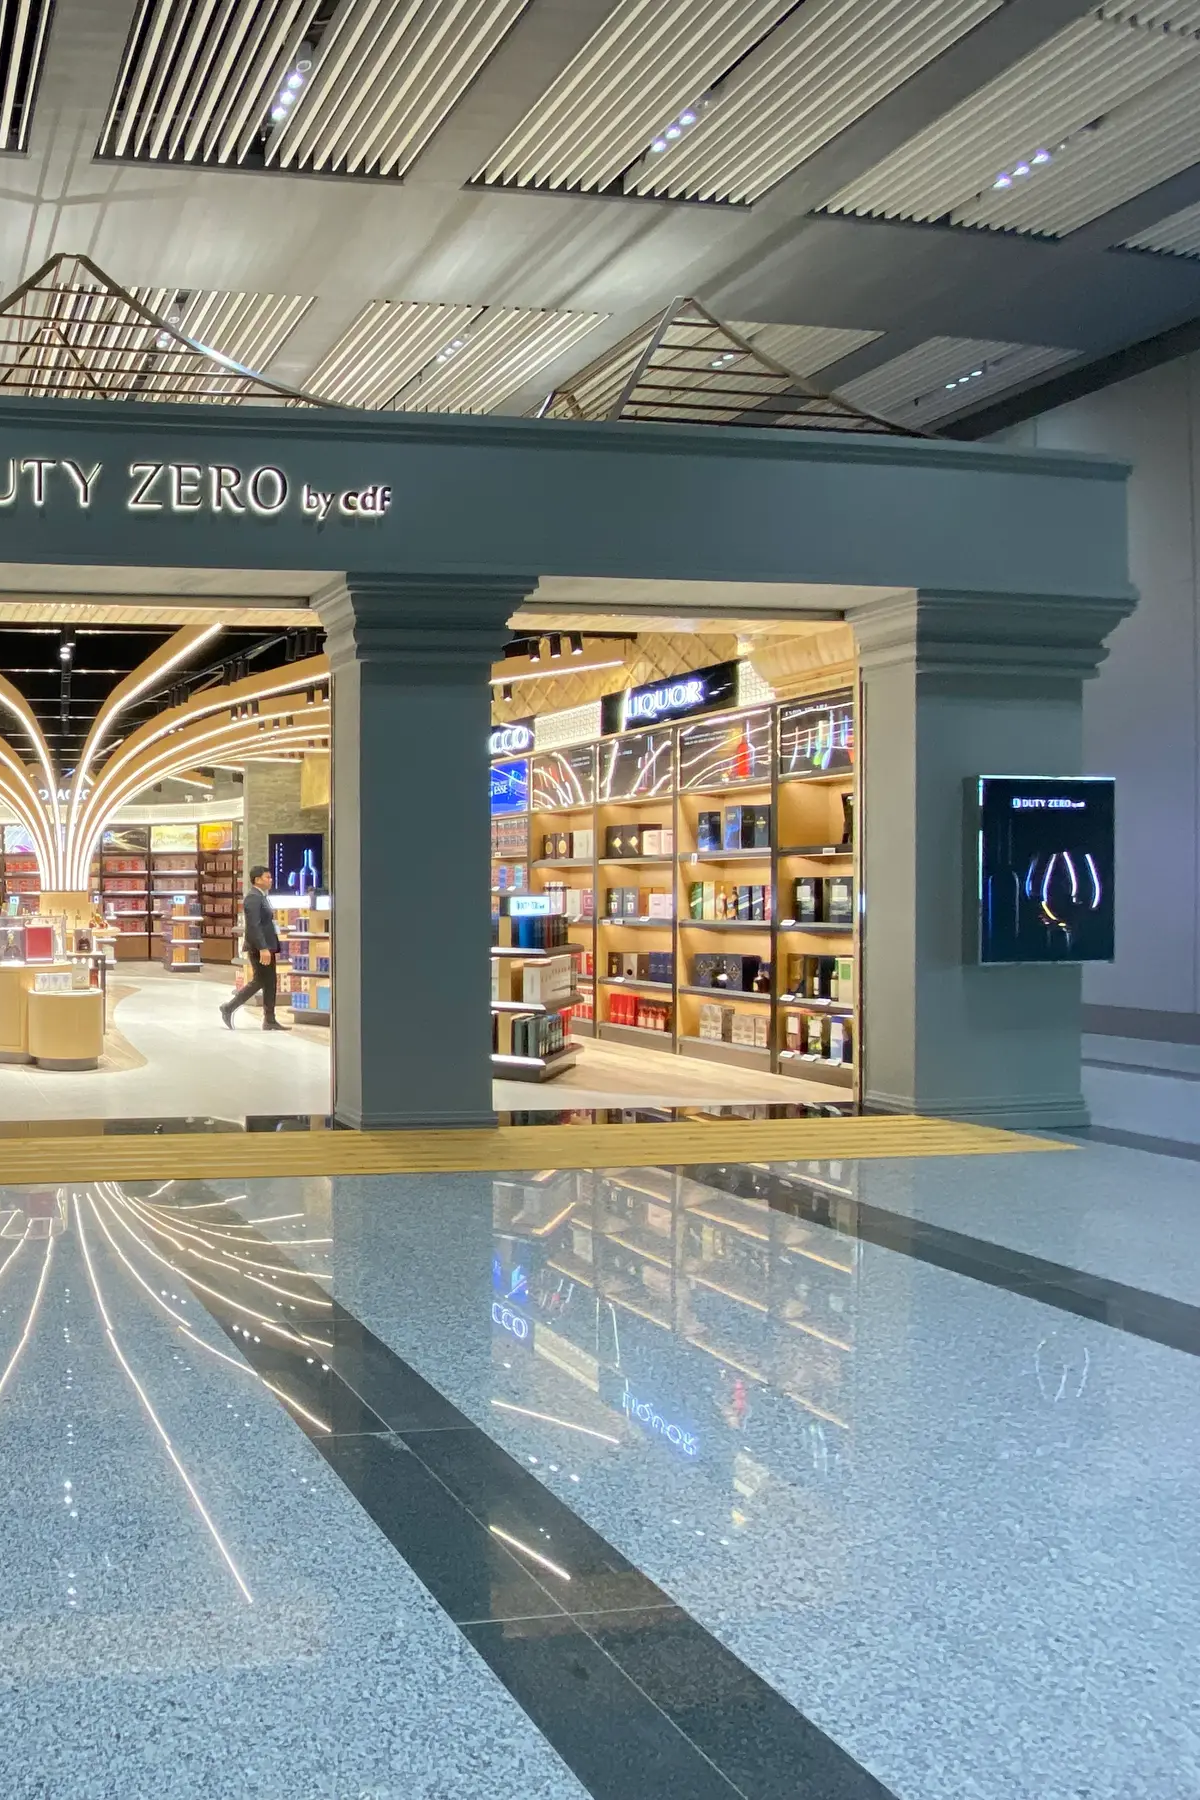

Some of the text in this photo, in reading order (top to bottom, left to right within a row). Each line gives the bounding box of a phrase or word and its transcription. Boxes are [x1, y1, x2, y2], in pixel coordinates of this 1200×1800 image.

[127, 461, 289, 516] ZERO
[302, 483, 335, 519] by
[339, 484, 392, 515] cdf
[626, 681, 704, 718] LIQUOR
[1022, 798, 1046, 808] DUTY
[1047, 798, 1071, 808] ZERO
